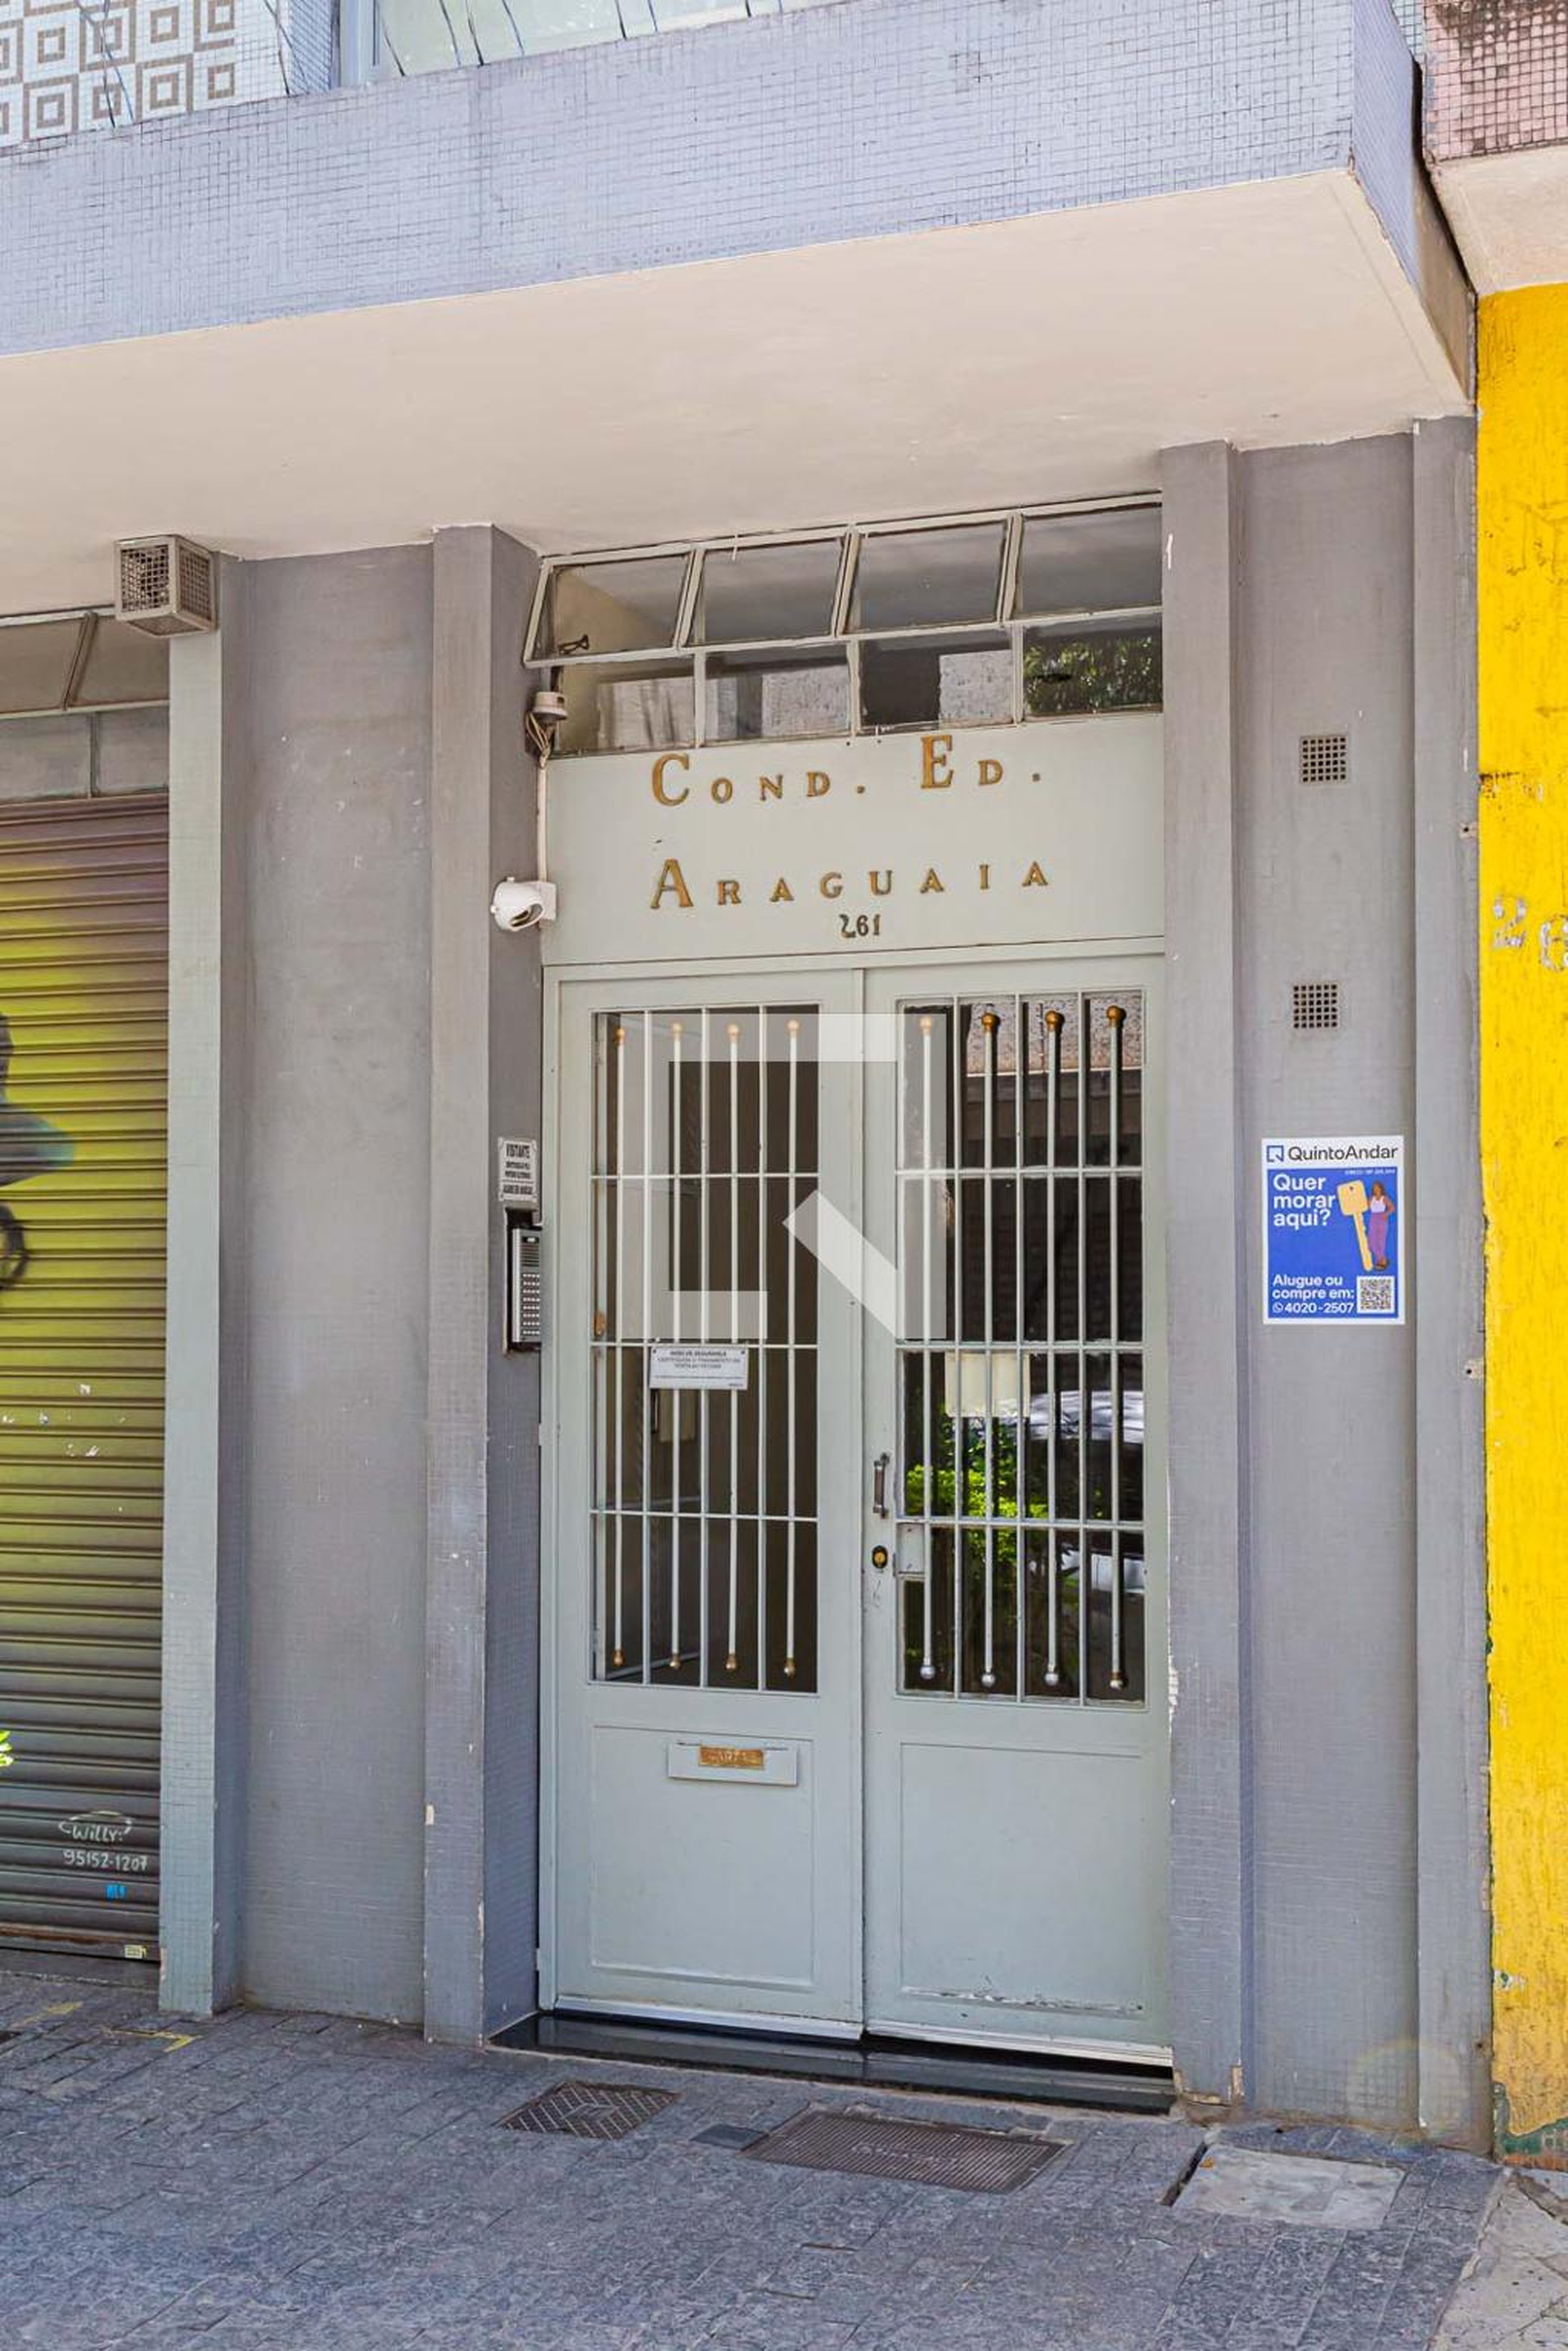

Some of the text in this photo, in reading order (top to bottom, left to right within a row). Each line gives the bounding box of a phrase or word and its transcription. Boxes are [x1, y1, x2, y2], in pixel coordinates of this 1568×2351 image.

[650, 858, 1048, 909] ARAGUAIA
[839, 913, 881, 938] 261
[1288, 1145, 1398, 1162] QuintoAndar
[1273, 1173, 1327, 1191] Quer
[1273, 1194, 1336, 1209] morar
[1273, 1209, 1331, 1231] aqui?
[1272, 1274, 1343, 1289] Alugue ou
[1272, 1288, 1355, 1300] compre em:
[1284, 1303, 1354, 1313] 4020-2507
